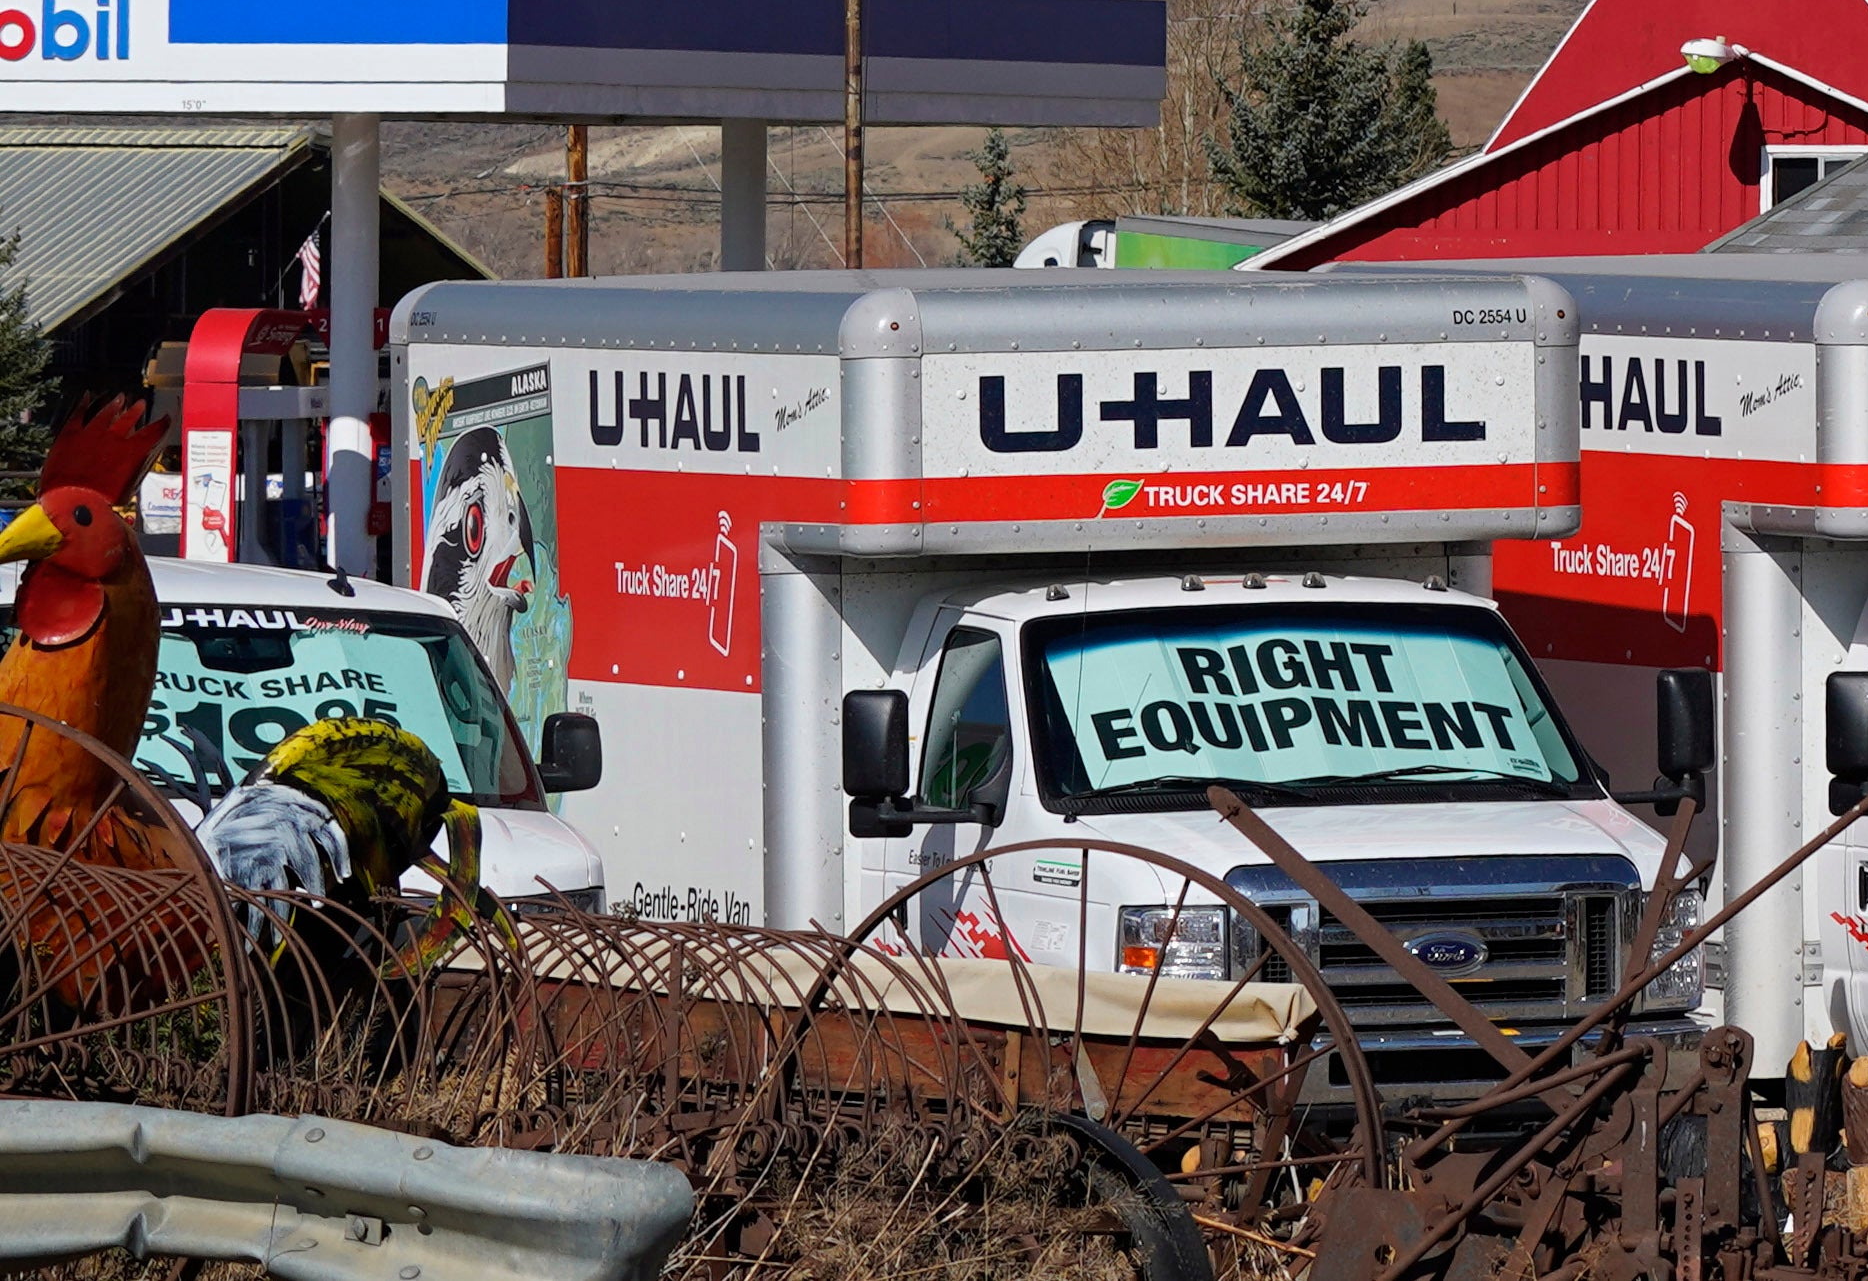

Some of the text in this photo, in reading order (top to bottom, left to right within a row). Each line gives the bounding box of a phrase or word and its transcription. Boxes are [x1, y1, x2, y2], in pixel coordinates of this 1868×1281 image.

[318, 319, 327, 332] 2
[376, 318, 385, 331] 1
[1453, 308, 1527, 324] DC 2554 U
[511, 369, 548, 397] ALASKA
[1580, 355, 1722, 437] HAUL
[589, 369, 760, 453] U-HAUL
[774, 402, 803, 433] Mom's
[979, 365, 1487, 453] U-HAUL
[1740, 386, 1773, 418] Mom's
[1144, 480, 1368, 507] TRUCK SHARE 24/7
[1551, 541, 1676, 585] Truck Share 24/7
[614, 561, 721, 606] Truck Share 24/7
[1176, 638, 1394, 696] RIGHT
[155, 668, 390, 699] RUCK SHARE
[1091, 696, 1518, 760] EQUIPMENT
[908, 849, 930, 866] Easier
[932, 852, 941, 866] To
[633, 881, 750, 927] Gentle-Ride Van
[1427, 944, 1466, 962] Ford
